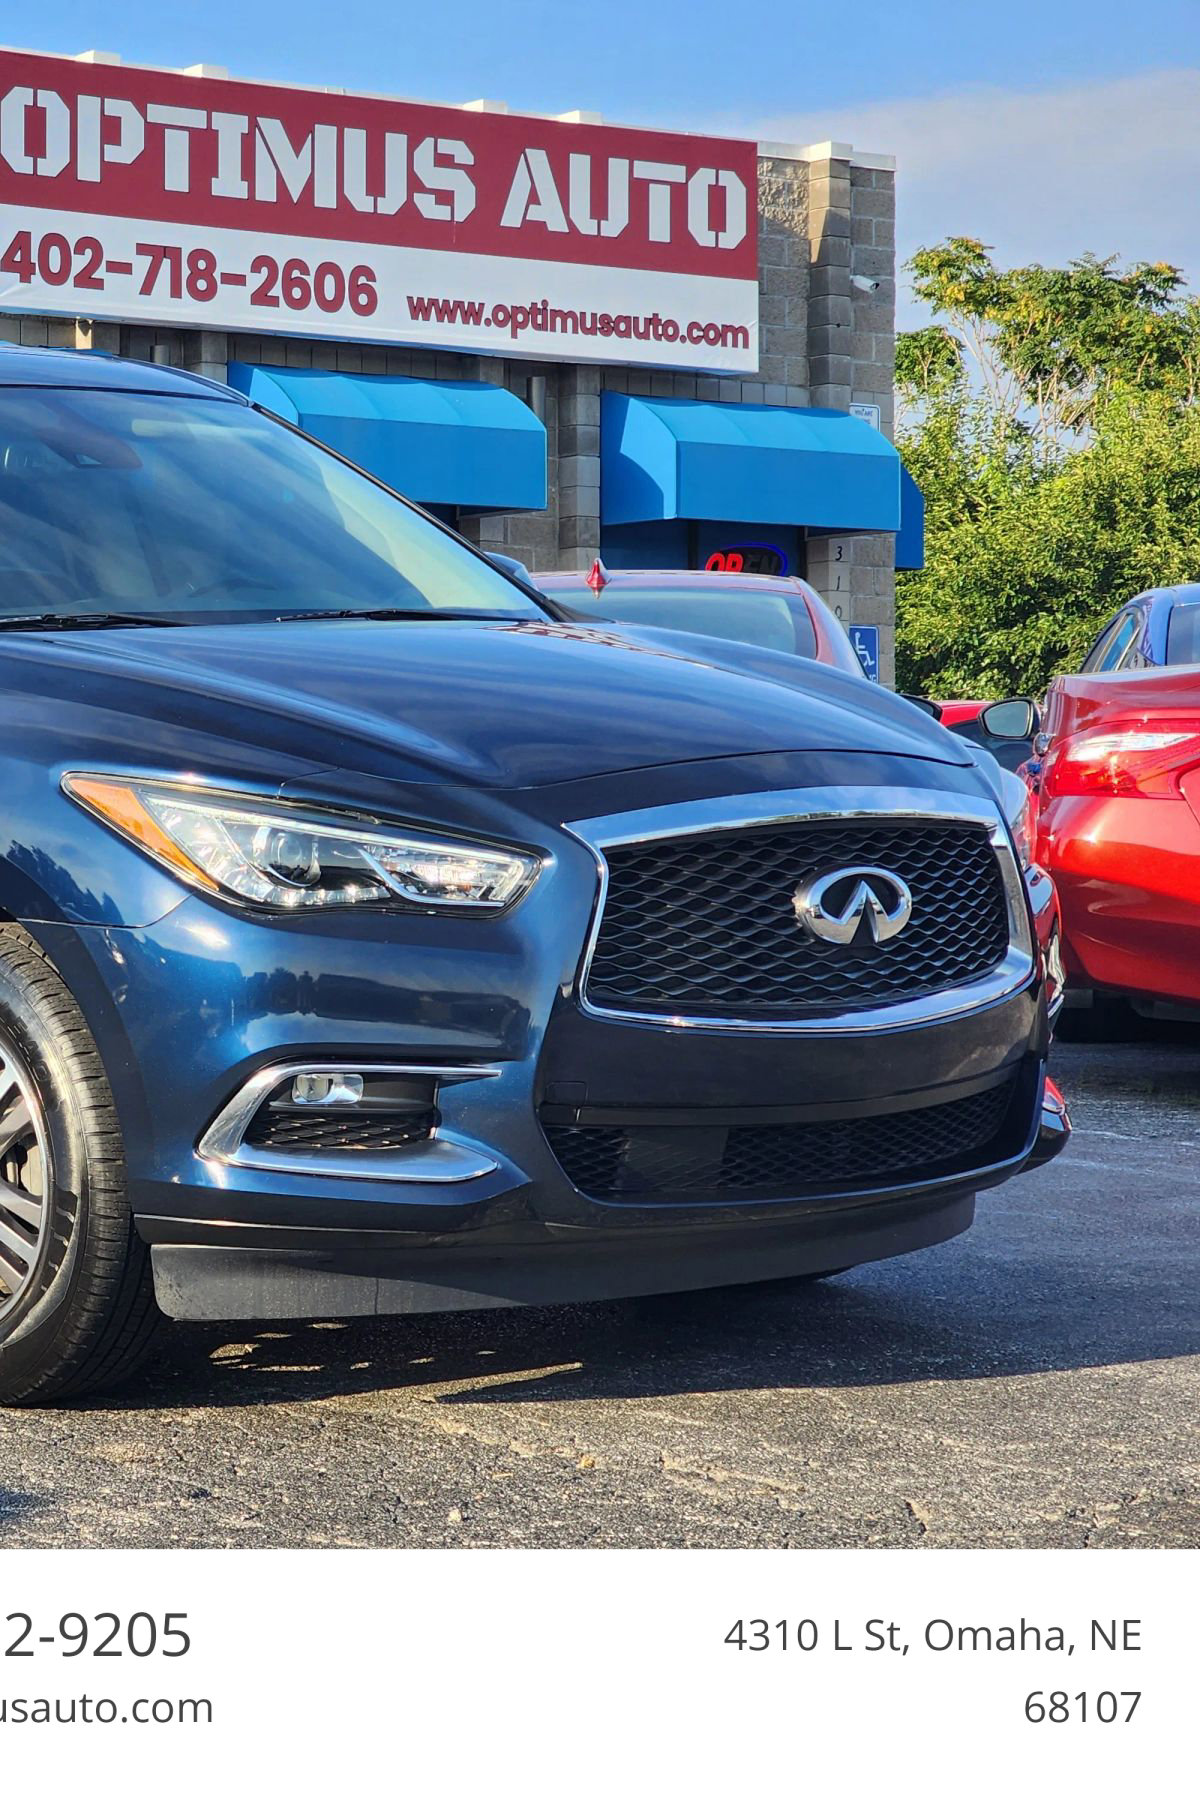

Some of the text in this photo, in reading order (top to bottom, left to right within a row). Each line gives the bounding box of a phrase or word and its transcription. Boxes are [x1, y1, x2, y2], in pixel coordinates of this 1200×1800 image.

[0, 85, 748, 250] OPTIMUS AUTO
[0, 230, 378, 317] 402-718-2606
[406, 295, 750, 349] www.optimusauto.com
